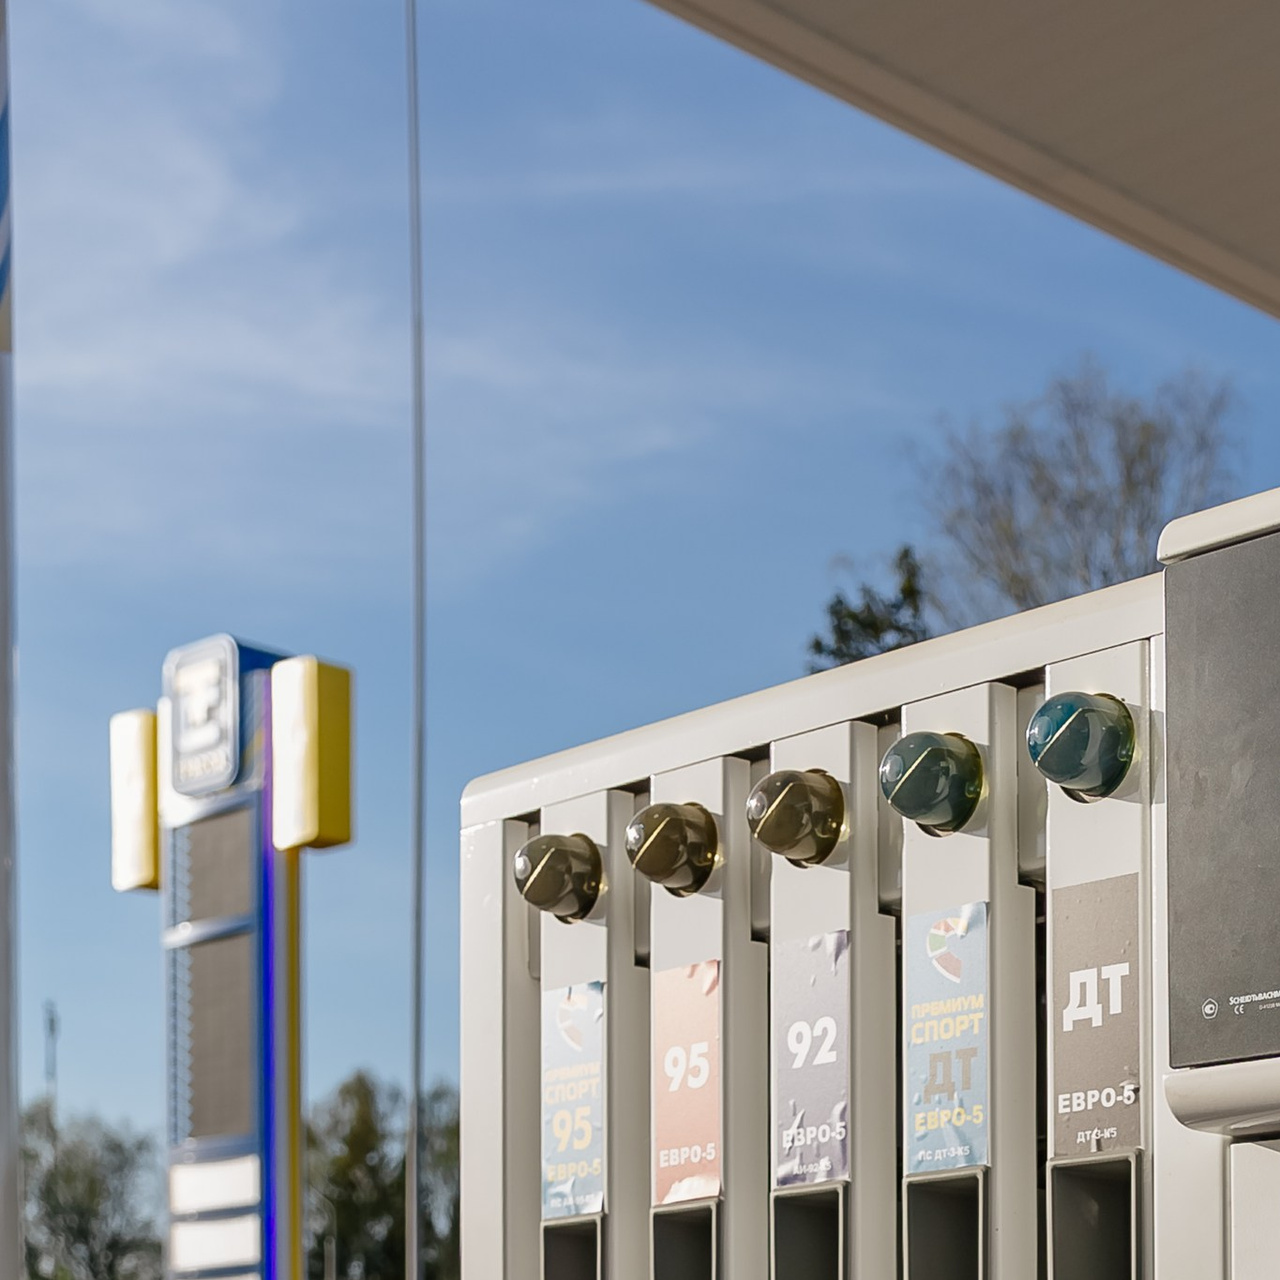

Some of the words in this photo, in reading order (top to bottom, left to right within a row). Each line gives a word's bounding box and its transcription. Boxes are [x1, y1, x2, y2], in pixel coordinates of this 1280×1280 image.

[911, 993, 985, 1020] ПРЕМИУМ
[1062, 962, 1130, 1033] ДТ
[787, 1016, 838, 1069] 92
[911, 1012, 985, 1045] СПОРТ
[664, 1041, 710, 1092] 95
[923, 1046, 978, 1105] ДТ
[545, 1076, 600, 1105] СПОРТ
[1058, 1084, 1136, 1114] ЕВРО-5
[553, 1105, 593, 1153] 95
[914, 1104, 984, 1132] ЕВРО-5
[782, 1121, 847, 1148] ЕВРО-5
[659, 1142, 716, 1168] ЕВРО-5
[547, 1158, 602, 1183] ЕВРО-5
